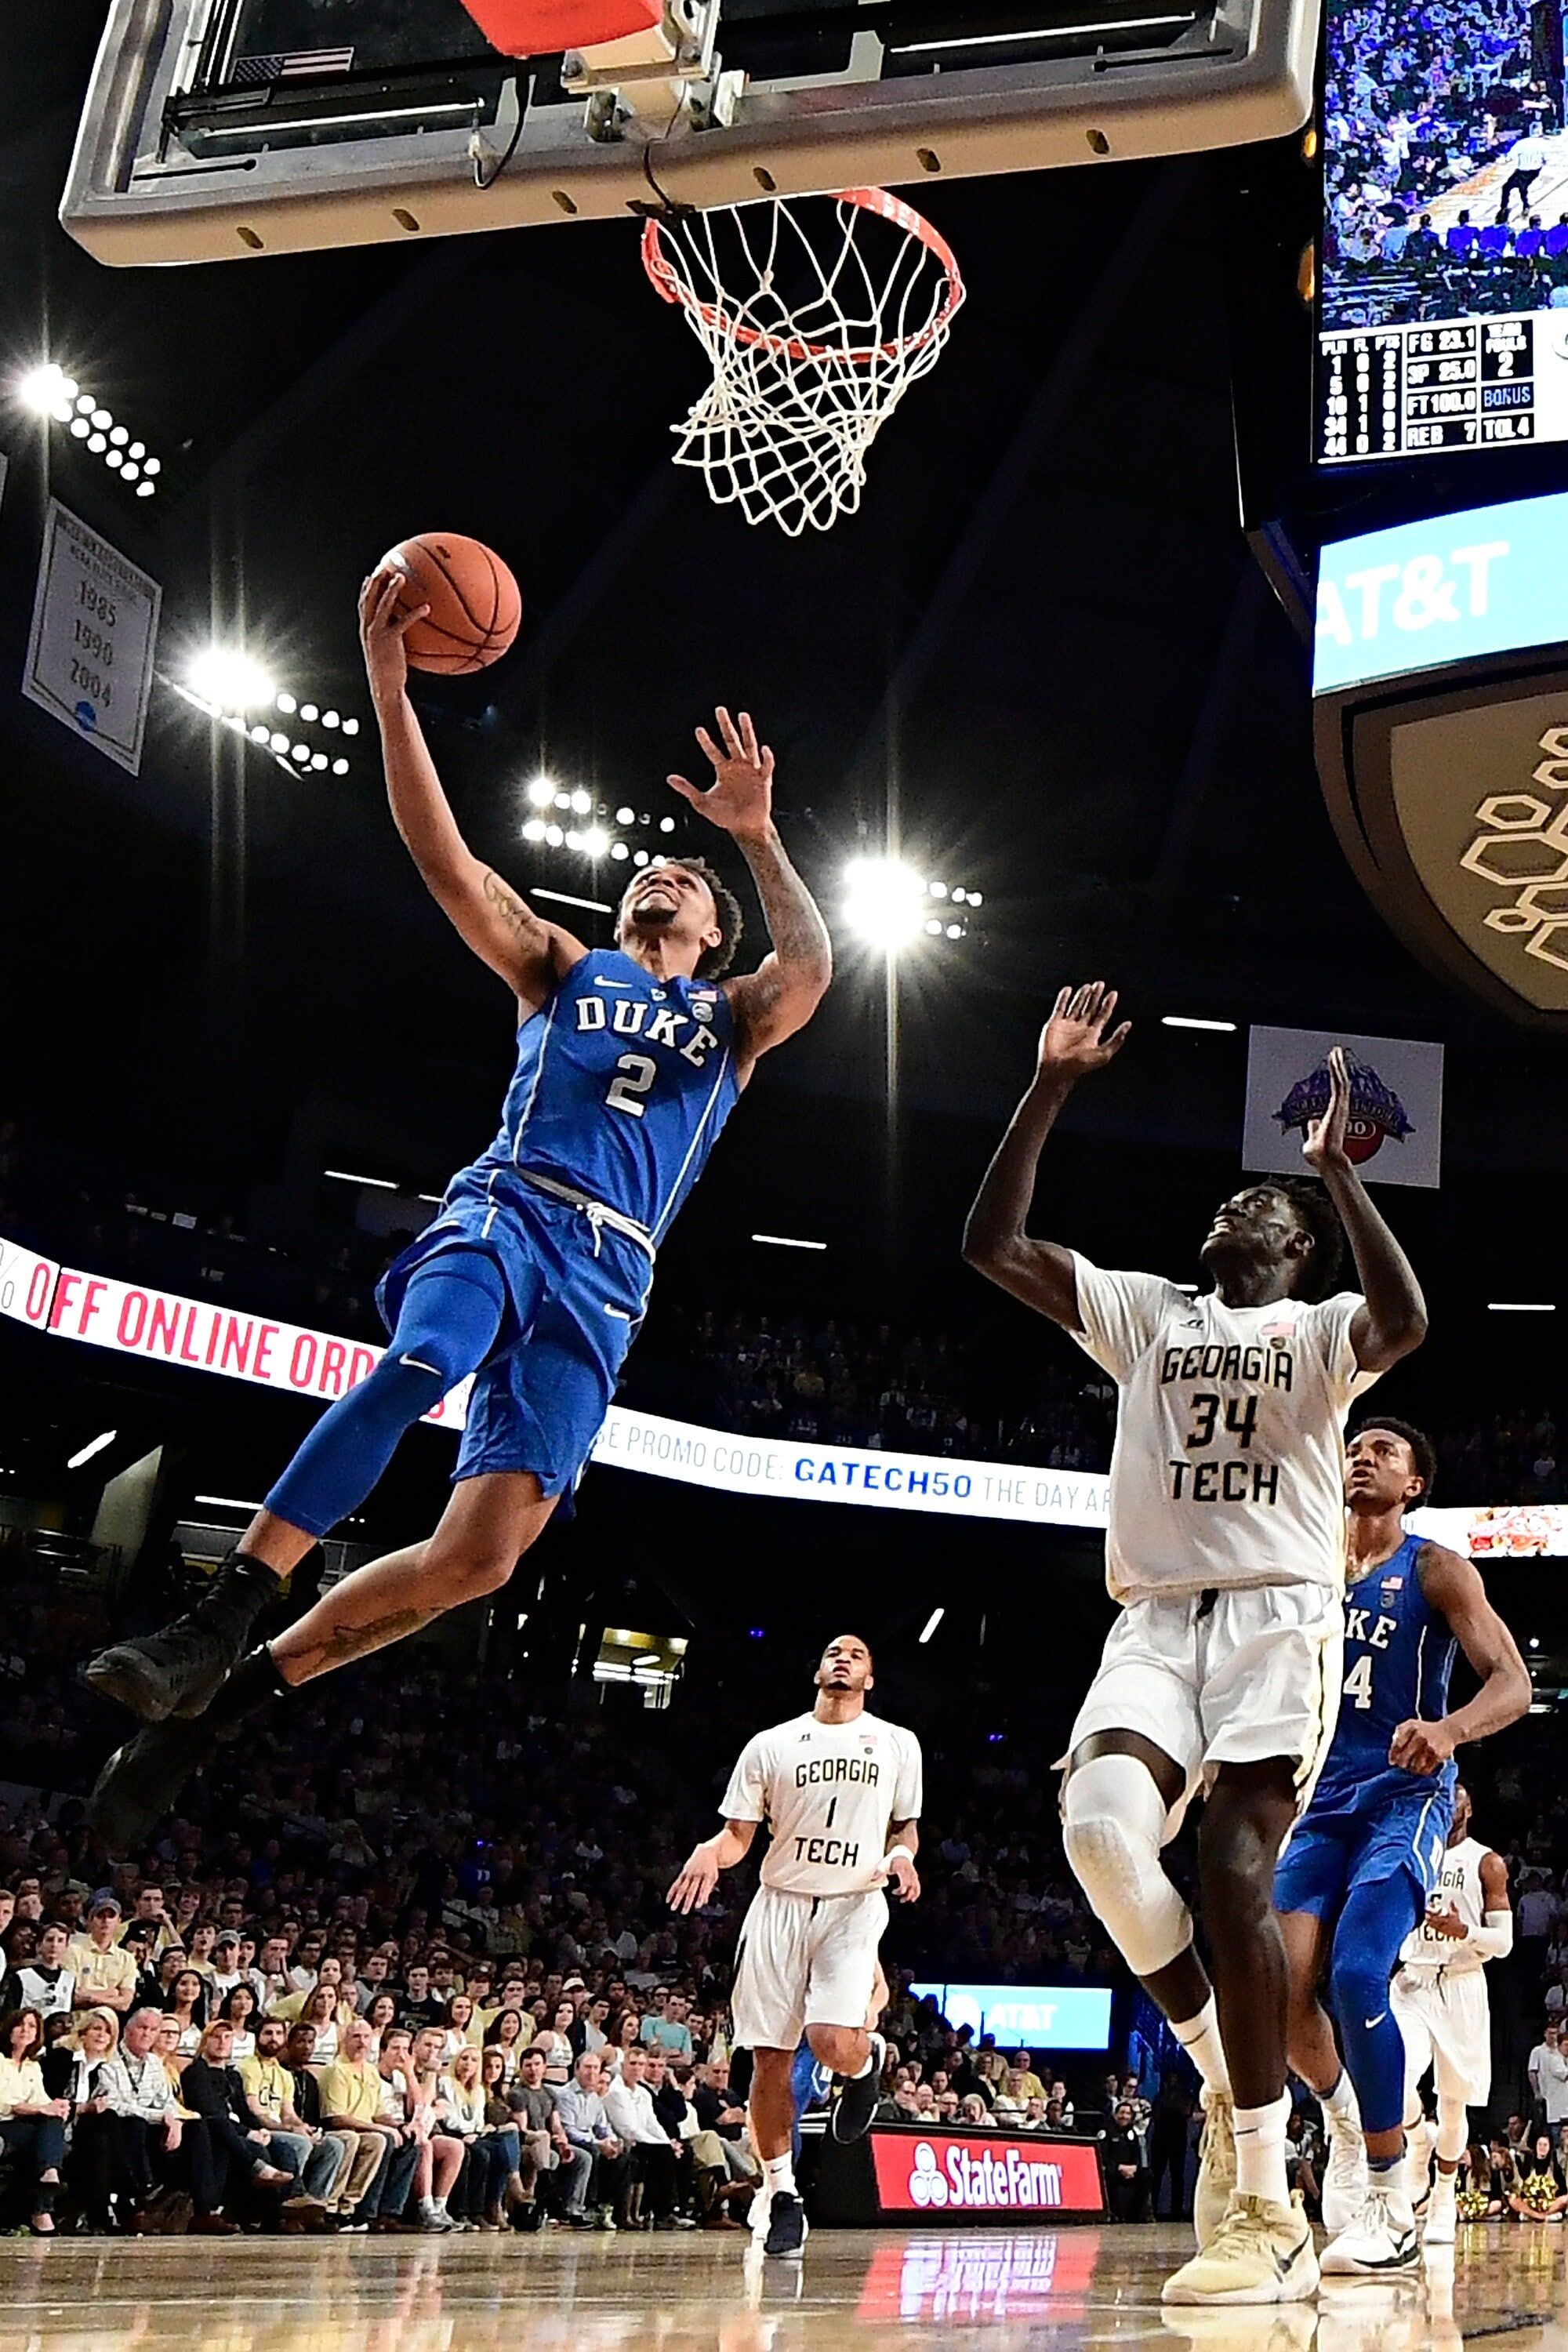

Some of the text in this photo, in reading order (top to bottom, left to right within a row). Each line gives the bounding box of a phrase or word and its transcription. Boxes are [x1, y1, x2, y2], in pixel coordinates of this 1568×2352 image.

[1409, 332, 1433, 353] FG
[1331, 350, 1396, 375] 1 0 2
[1439, 359, 1475, 382] 25.0
[1497, 351, 1514, 377] 2
[1330, 371, 1396, 395] 5 0 2
[1484, 387, 1530, 407] BONUS
[1327, 395, 1347, 416] 10
[1358, 394, 1368, 412] 1
[1407, 390, 1475, 416] FT 100.0
[1324, 416, 1347, 437] 34
[1358, 414, 1367, 433] 1
[1407, 422, 1476, 447] REB 7
[1517, 416, 1529, 437] 4
[1323, 431, 1396, 456] 44 0 2
[80, 581, 116, 626] 1985
[1315, 540, 1510, 645] AT&T
[75, 619, 113, 666] 1990
[71, 659, 111, 708] 2004
[575, 996, 719, 1067] DUKE
[605, 1054, 656, 1117] 2
[26, 1263, 107, 1334] OFF
[118, 1291, 279, 1379] ONLINE
[1161, 1345, 1293, 1392] GEORGIA
[1186, 1393, 1258, 1449] 34
[627, 1427, 706, 1467] PROMO
[713, 1447, 783, 1480] CODE:
[794, 1458, 971, 1497] GATECH50
[983, 1477, 1026, 1504] THE
[1036, 1483, 1079, 1509] DAY
[1169, 1461, 1279, 1505] TECH
[1345, 1609, 1397, 1650] KE
[1342, 1656, 1372, 1709] 4
[795, 1758, 880, 1788] GEORGIA
[825, 1795, 837, 1828] 1
[794, 1837, 859, 1867] TECH
[987, 2004, 1058, 2031] AT&T
